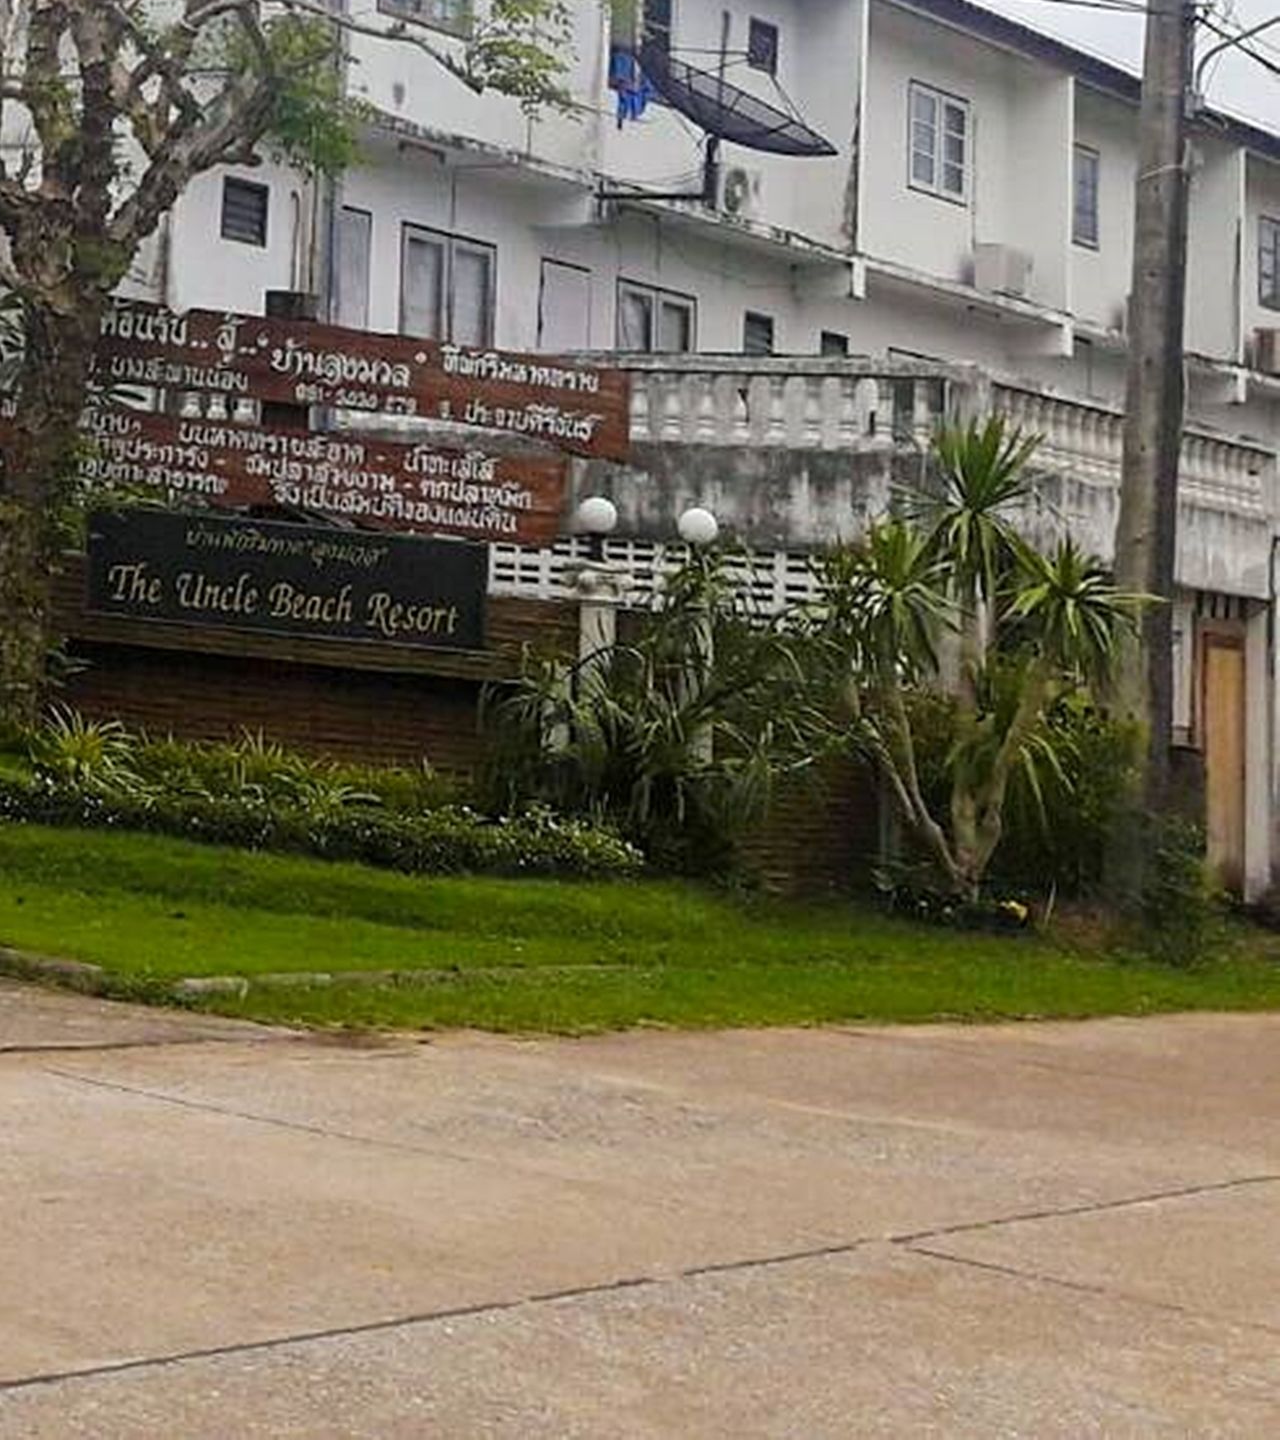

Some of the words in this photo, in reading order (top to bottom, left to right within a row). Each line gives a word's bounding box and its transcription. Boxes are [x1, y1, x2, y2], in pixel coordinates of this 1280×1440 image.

[108, 562, 163, 603] The
[175, 571, 260, 614] Uncle
[268, 581, 353, 624] Beach
[365, 591, 461, 637] Resort
